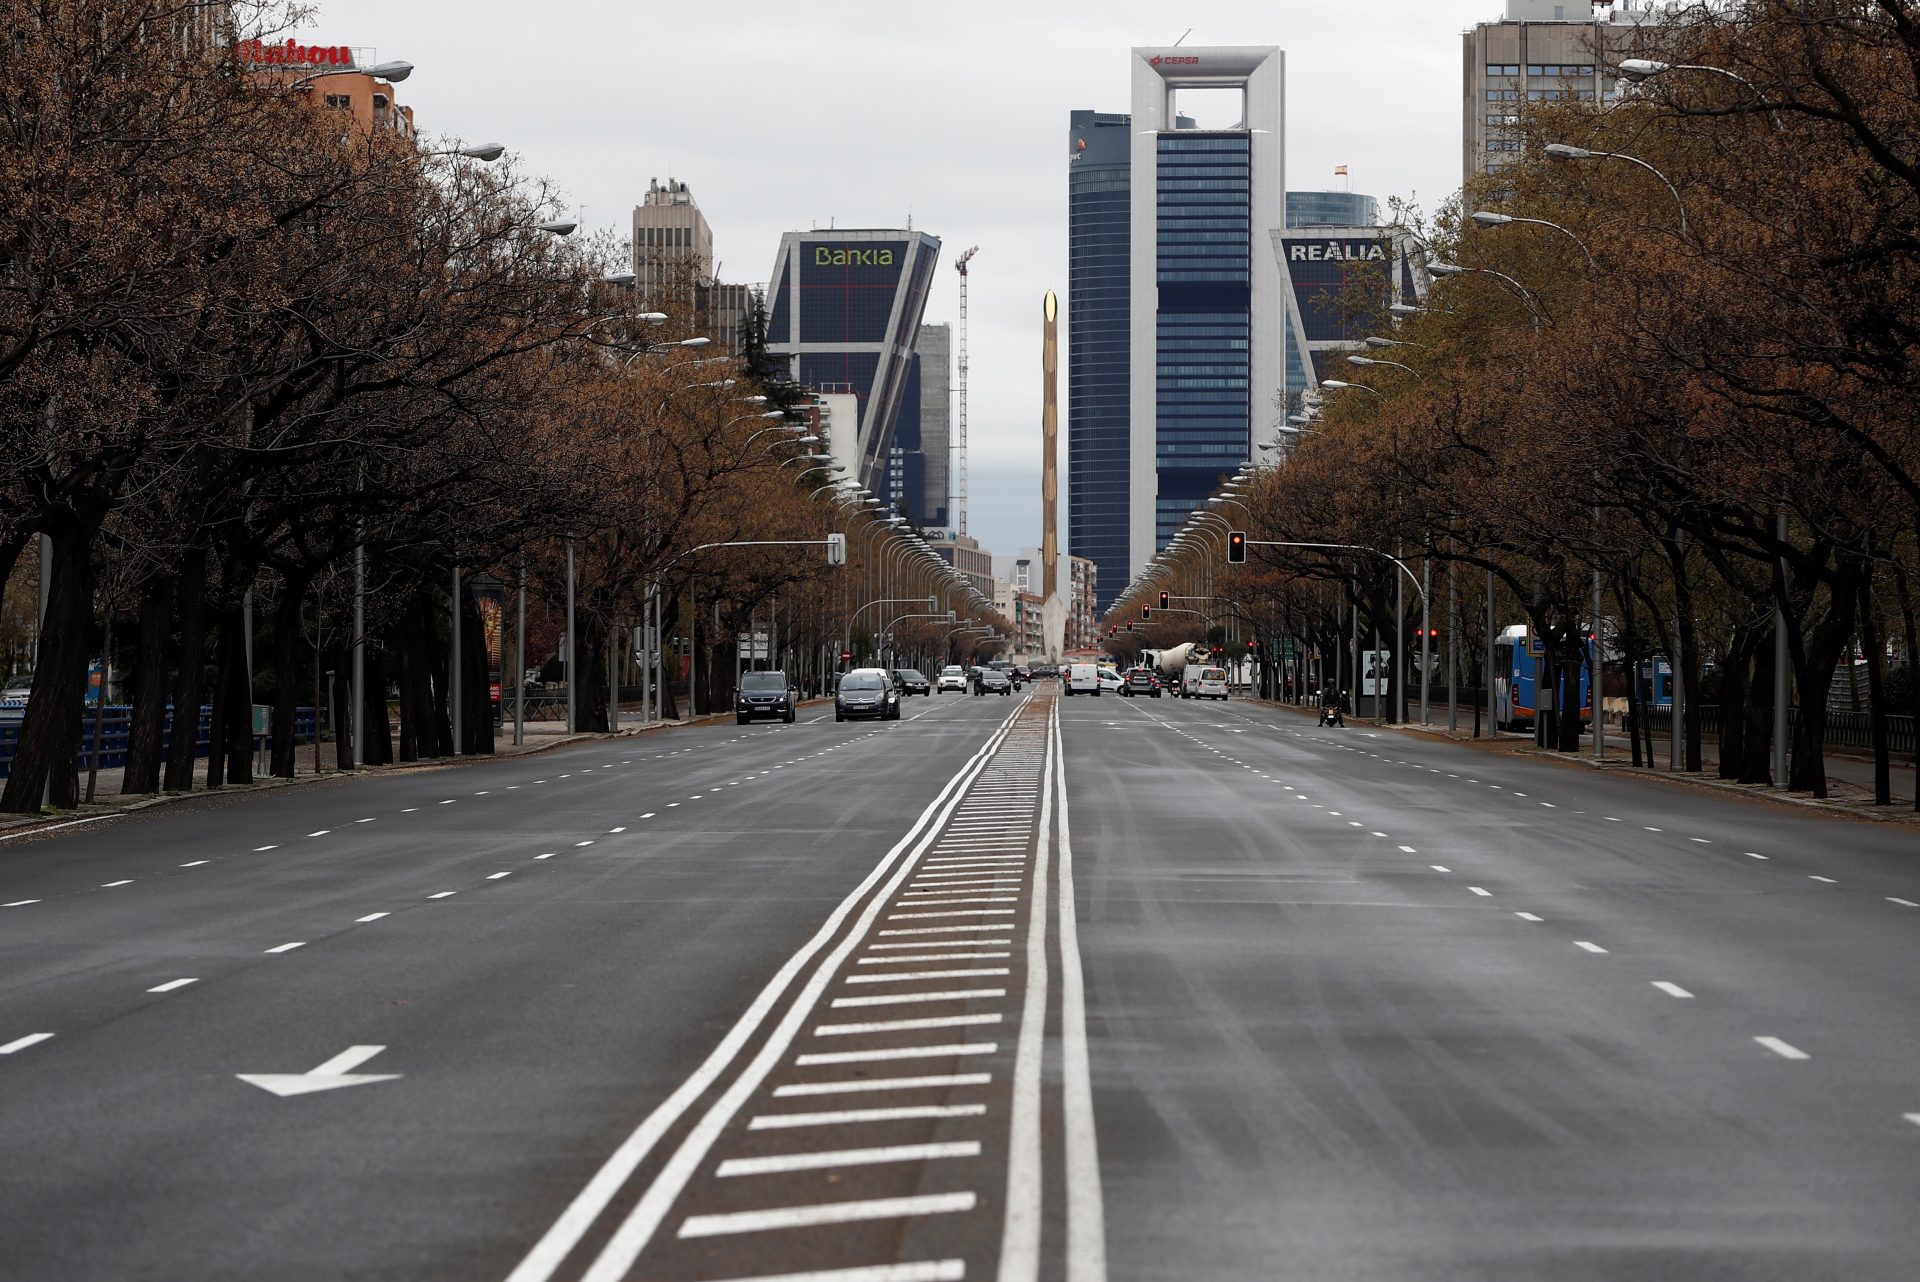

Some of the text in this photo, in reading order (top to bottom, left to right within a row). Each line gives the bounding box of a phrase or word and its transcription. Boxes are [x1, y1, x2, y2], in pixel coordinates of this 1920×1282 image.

[1164, 56, 1199, 65] CEPSA
[815, 246, 893, 266] Bankia
[1291, 241, 1386, 261] REALIA
